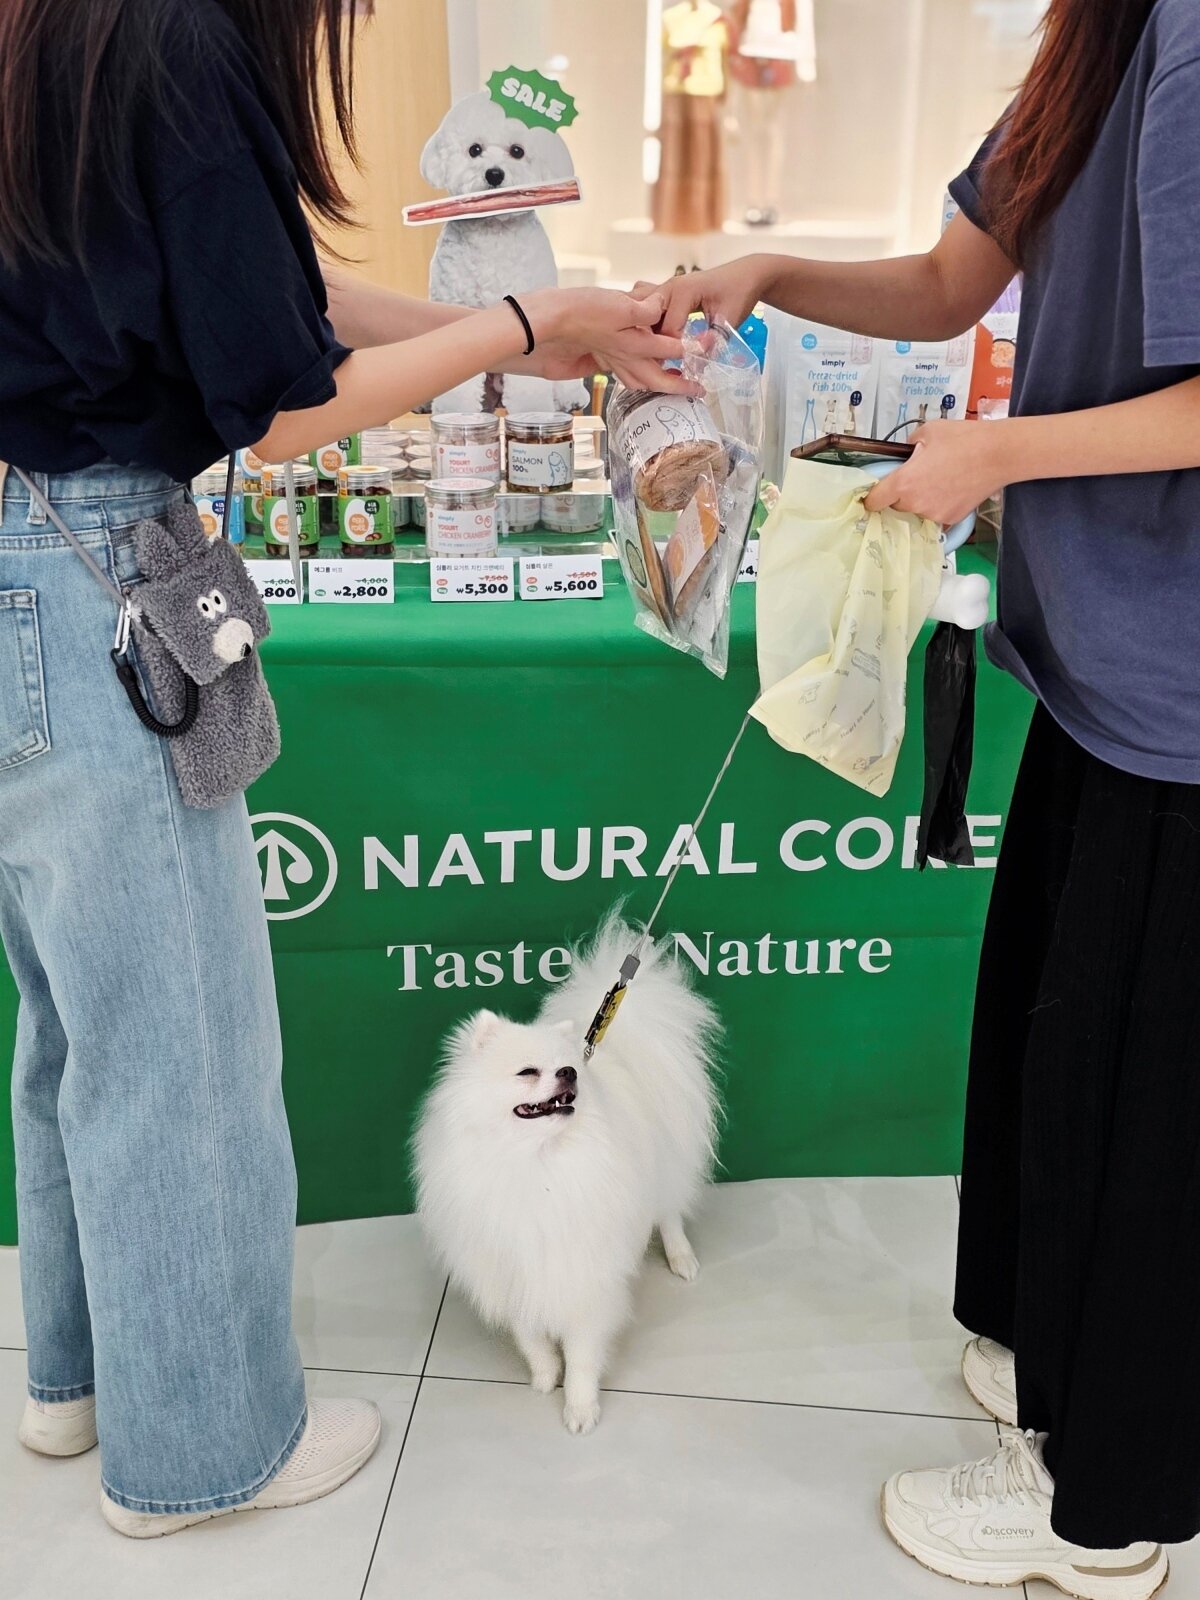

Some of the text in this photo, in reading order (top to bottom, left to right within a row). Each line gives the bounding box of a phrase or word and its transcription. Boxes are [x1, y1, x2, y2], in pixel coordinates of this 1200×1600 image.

[501, 77, 567, 122] SALE
[821, 359, 845, 367] simply
[915, 363, 939, 371] simply
[512, 456, 543, 465] SALMON
[512, 465, 529, 473] 100%
[333, 586, 388, 598] ₩2,800
[456, 583, 508, 596] ₩5,300
[545, 579, 597, 593] ₩5,600
[363, 822, 758, 890] NATURAL
[387, 931, 892, 991] Taste Nature
[984, 1525, 1035, 1538] Discovery
